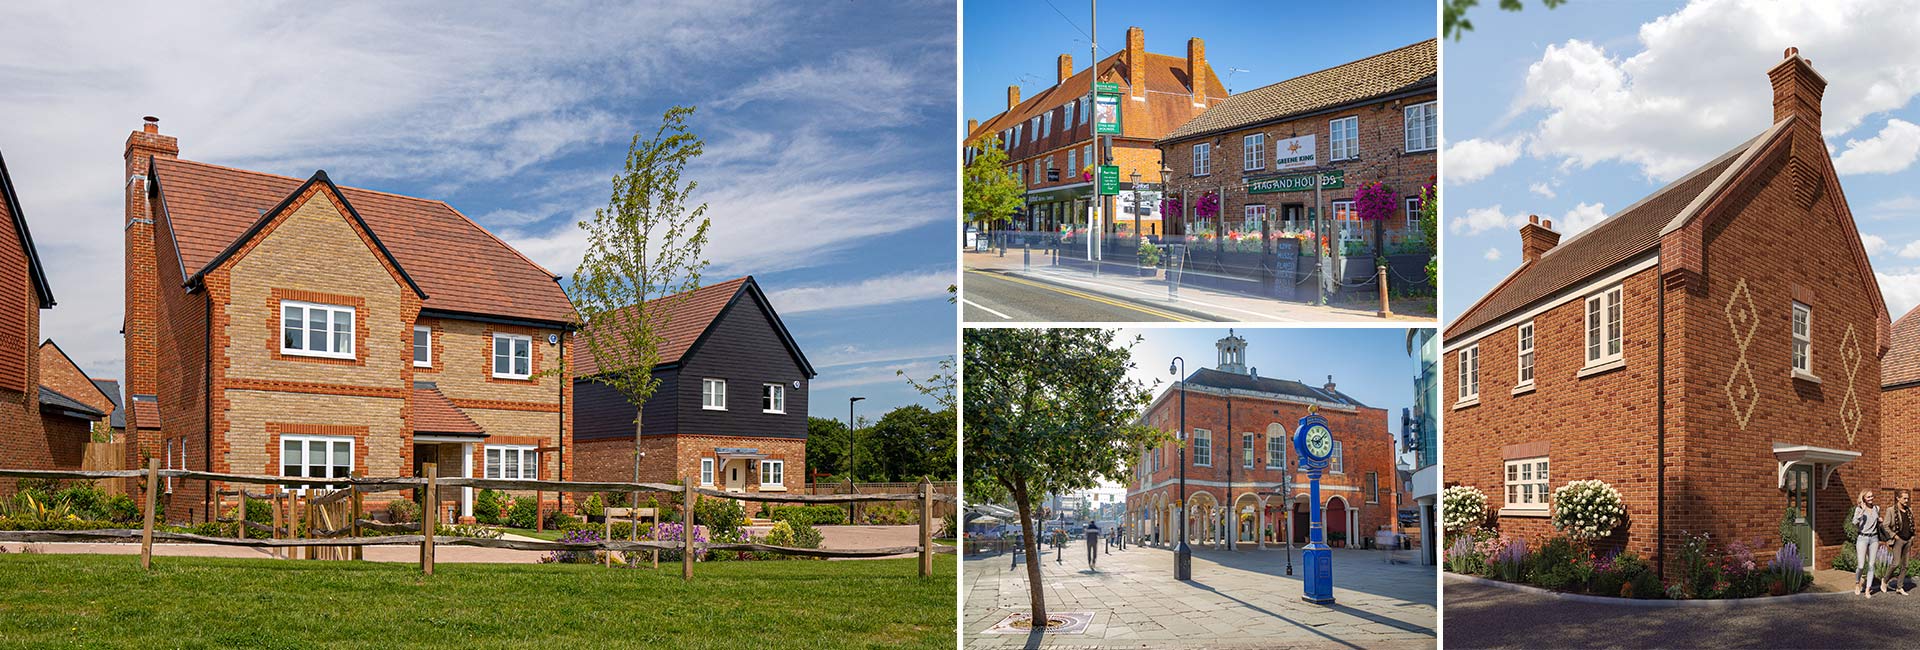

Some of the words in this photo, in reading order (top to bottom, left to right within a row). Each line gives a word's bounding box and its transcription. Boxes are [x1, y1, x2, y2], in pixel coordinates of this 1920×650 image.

[1277, 156, 1298, 165] GREENE
[1299, 154, 1314, 162] KING
[1253, 181, 1273, 190] STAG
[1273, 179, 1293, 188] AND
[1294, 175, 1336, 187] HOUDS
